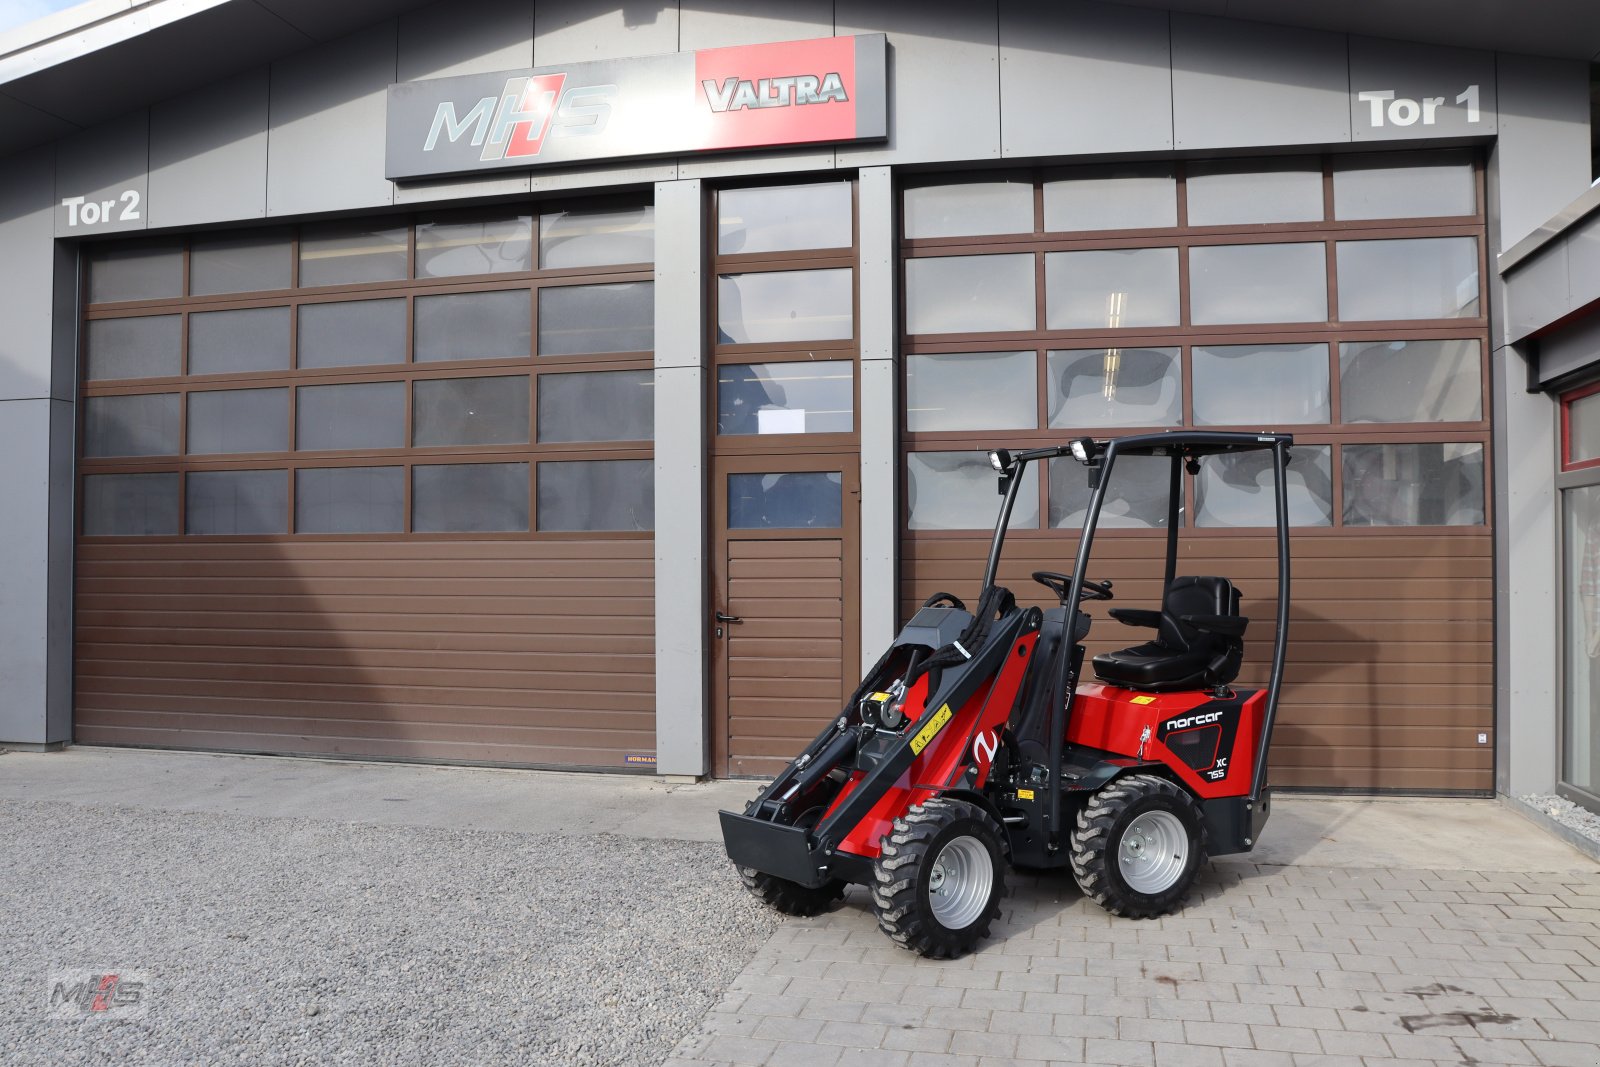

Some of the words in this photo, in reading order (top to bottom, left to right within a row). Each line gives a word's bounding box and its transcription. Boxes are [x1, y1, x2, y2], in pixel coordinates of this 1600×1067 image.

[702, 72, 849, 113] VALTRA
[1358, 90, 1445, 127] Tor
[1456, 84, 1480, 123] 1
[424, 78, 617, 156] MHS
[62, 196, 116, 226] Tor
[119, 190, 140, 221] 2
[1167, 711, 1223, 730] norcar
[1216, 757, 1227, 768] XC
